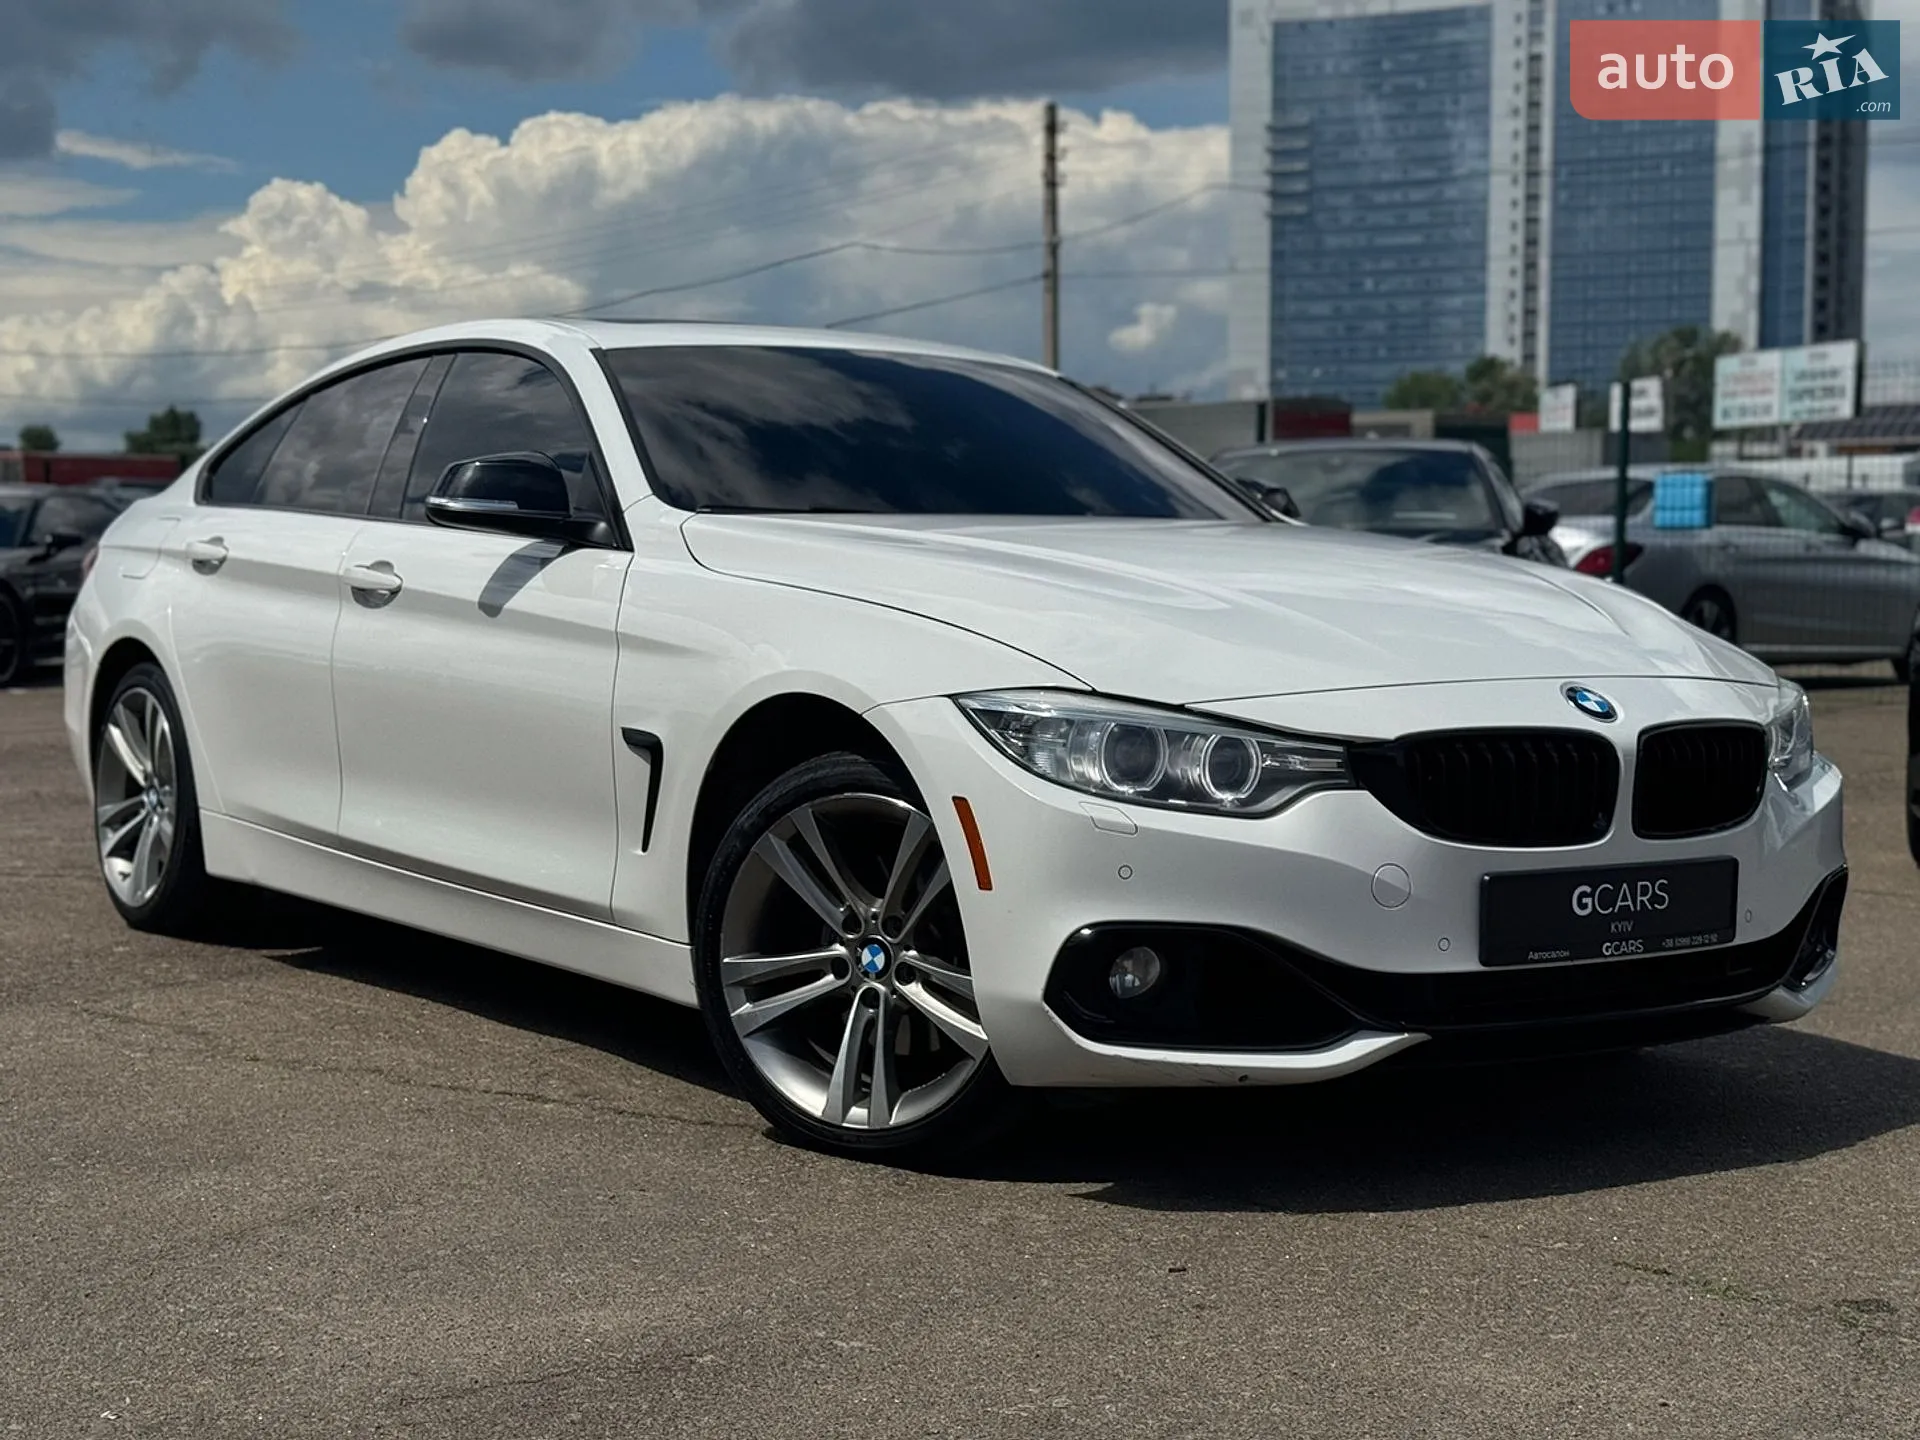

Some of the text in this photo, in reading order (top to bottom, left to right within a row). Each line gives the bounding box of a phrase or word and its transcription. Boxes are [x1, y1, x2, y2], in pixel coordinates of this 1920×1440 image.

[1571, 879, 1670, 917] GCARS
[1610, 920, 1635, 933] KYIV
[1602, 939, 1645, 956] GCARS
